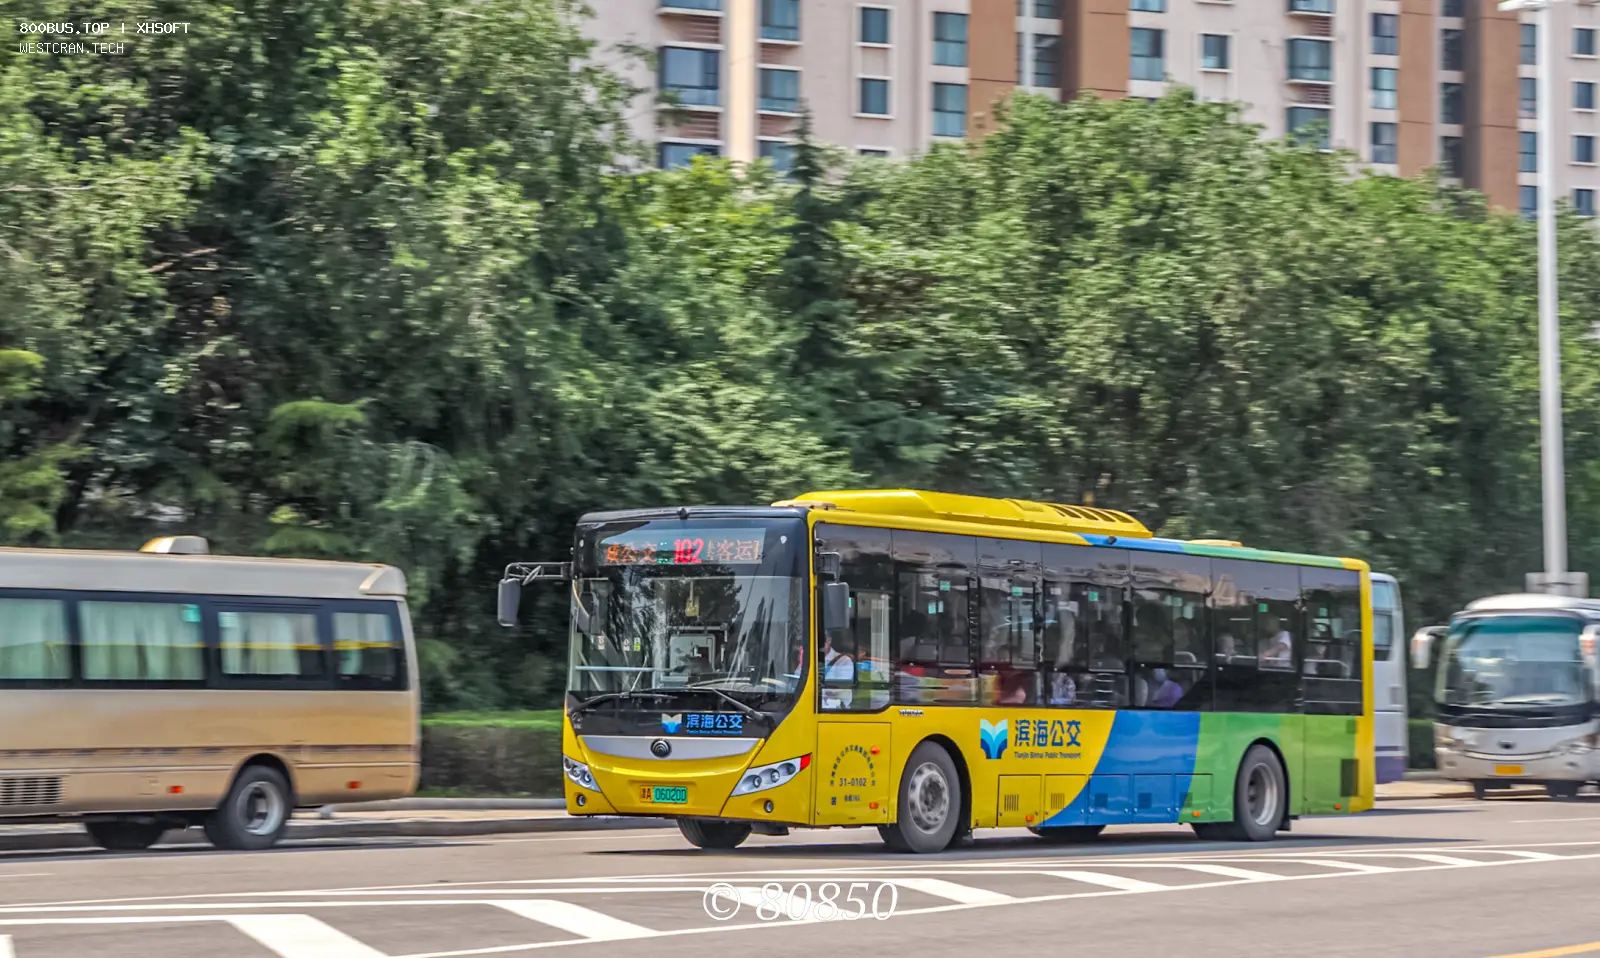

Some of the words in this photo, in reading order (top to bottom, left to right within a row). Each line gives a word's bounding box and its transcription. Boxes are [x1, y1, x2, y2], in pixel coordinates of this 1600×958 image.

[674, 538, 704, 563] 102
[686, 714, 743, 729] 滨海公交
[1014, 719, 1081, 747] 滨海公交
[839, 777, 868, 787] 31-0102
